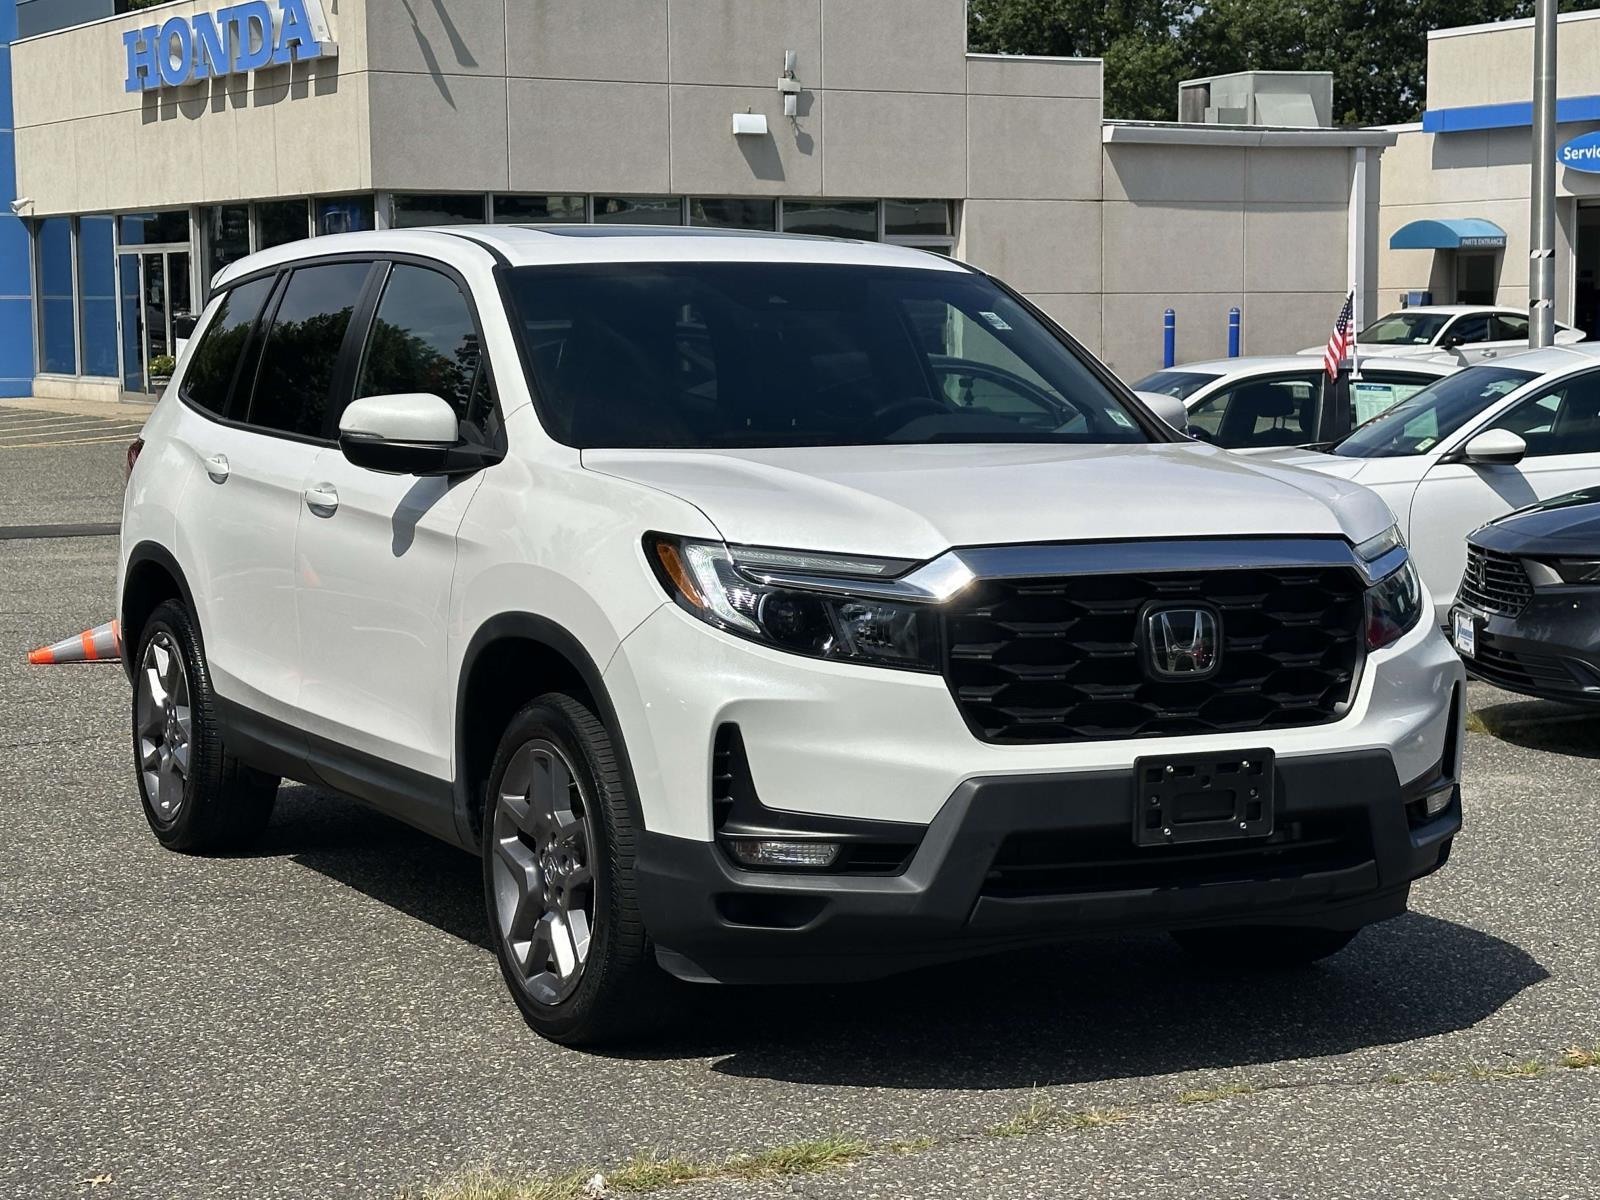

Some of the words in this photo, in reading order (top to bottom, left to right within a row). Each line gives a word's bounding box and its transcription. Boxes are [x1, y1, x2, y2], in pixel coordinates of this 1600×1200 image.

[123, 0, 320, 93] HONDA
[1461, 238, 1478, 246] PARTS
[1479, 238, 1503, 246] ENTRANCE
